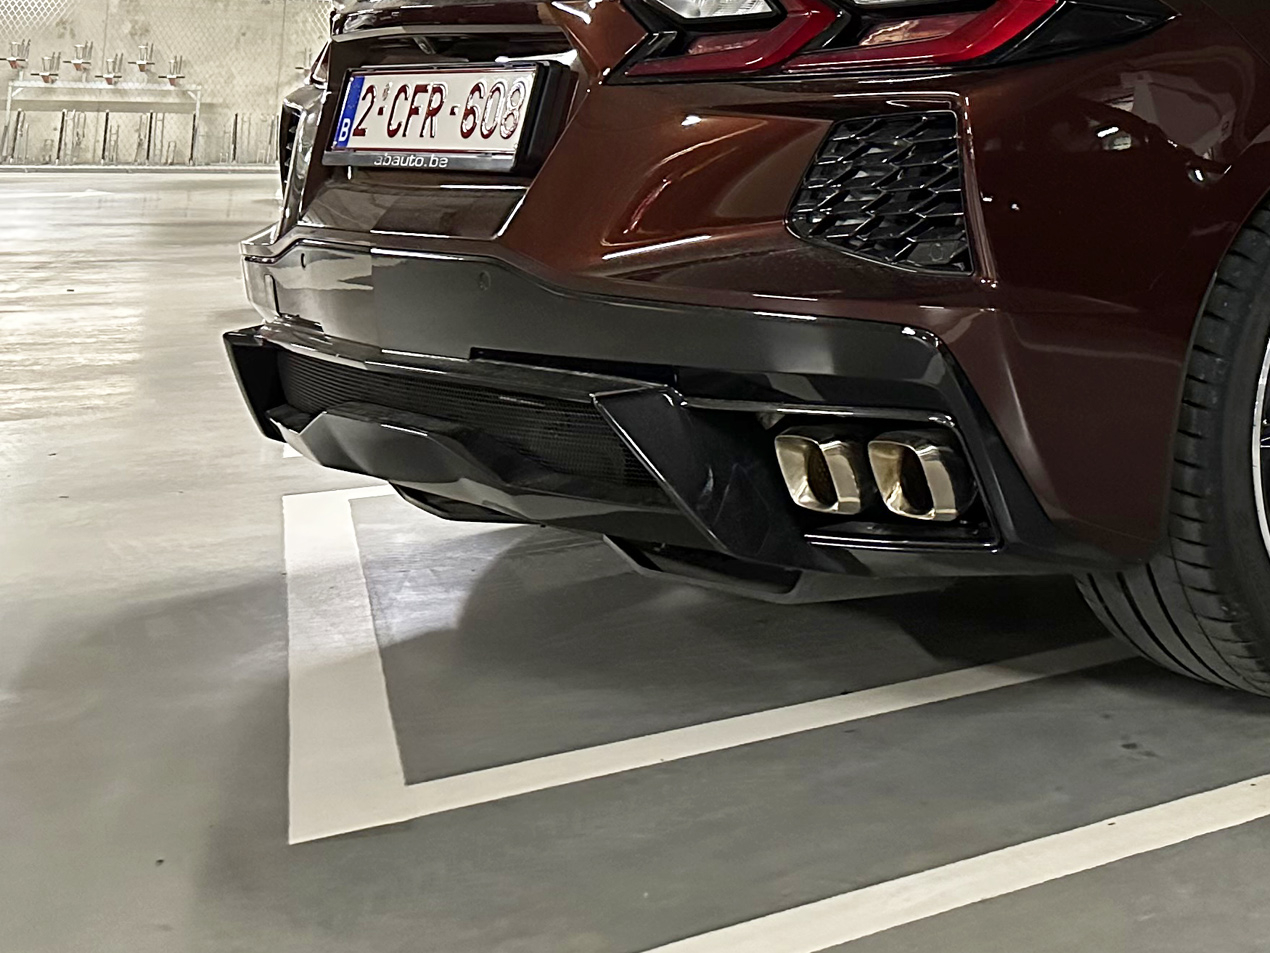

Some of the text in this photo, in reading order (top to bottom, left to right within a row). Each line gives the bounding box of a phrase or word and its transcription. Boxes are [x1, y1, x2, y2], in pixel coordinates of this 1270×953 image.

[352, 77, 526, 140] 2-CFR-608
[338, 118, 349, 142] B
[374, 154, 449, 168] abauto.be
